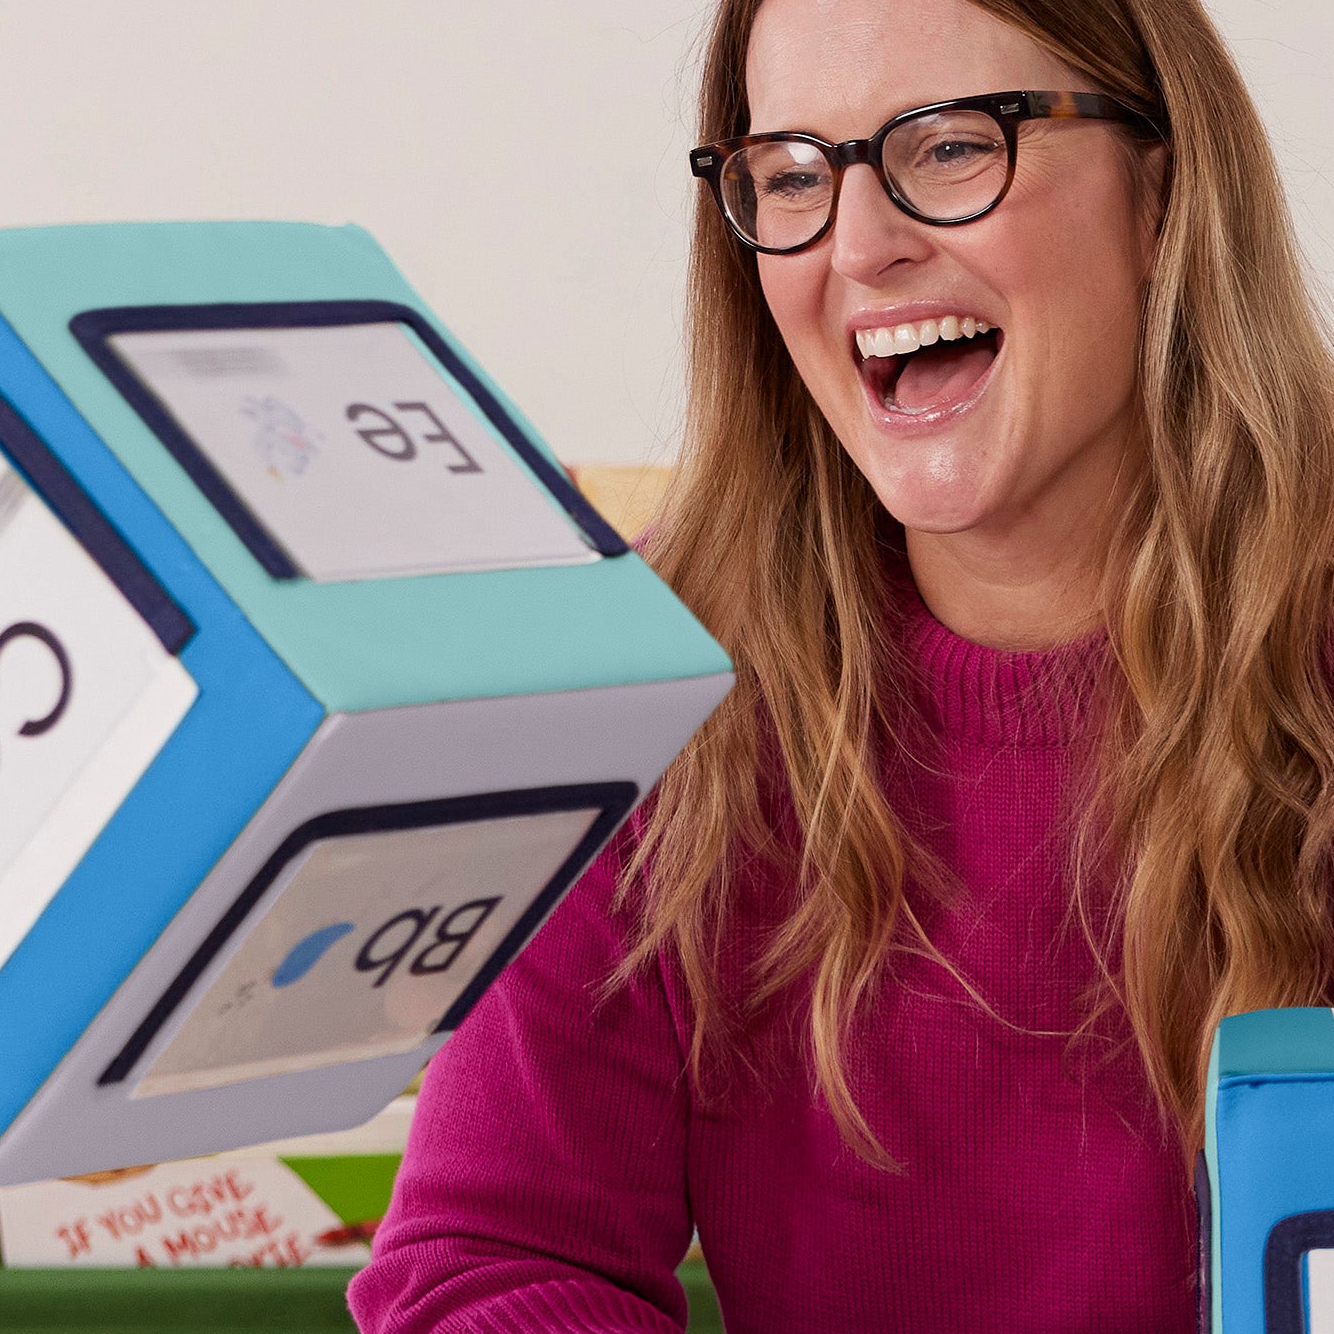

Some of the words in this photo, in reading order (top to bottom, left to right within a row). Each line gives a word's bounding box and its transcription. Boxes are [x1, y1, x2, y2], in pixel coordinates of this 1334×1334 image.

[345, 401, 485, 475] Ee
[354, 895, 504, 989] Bb
[55, 1216, 91, 1259] IF
[96, 1192, 163, 1241] YOU
[167, 1168, 255, 1219] GIVE
[162, 1207, 284, 1263] MOUSE
